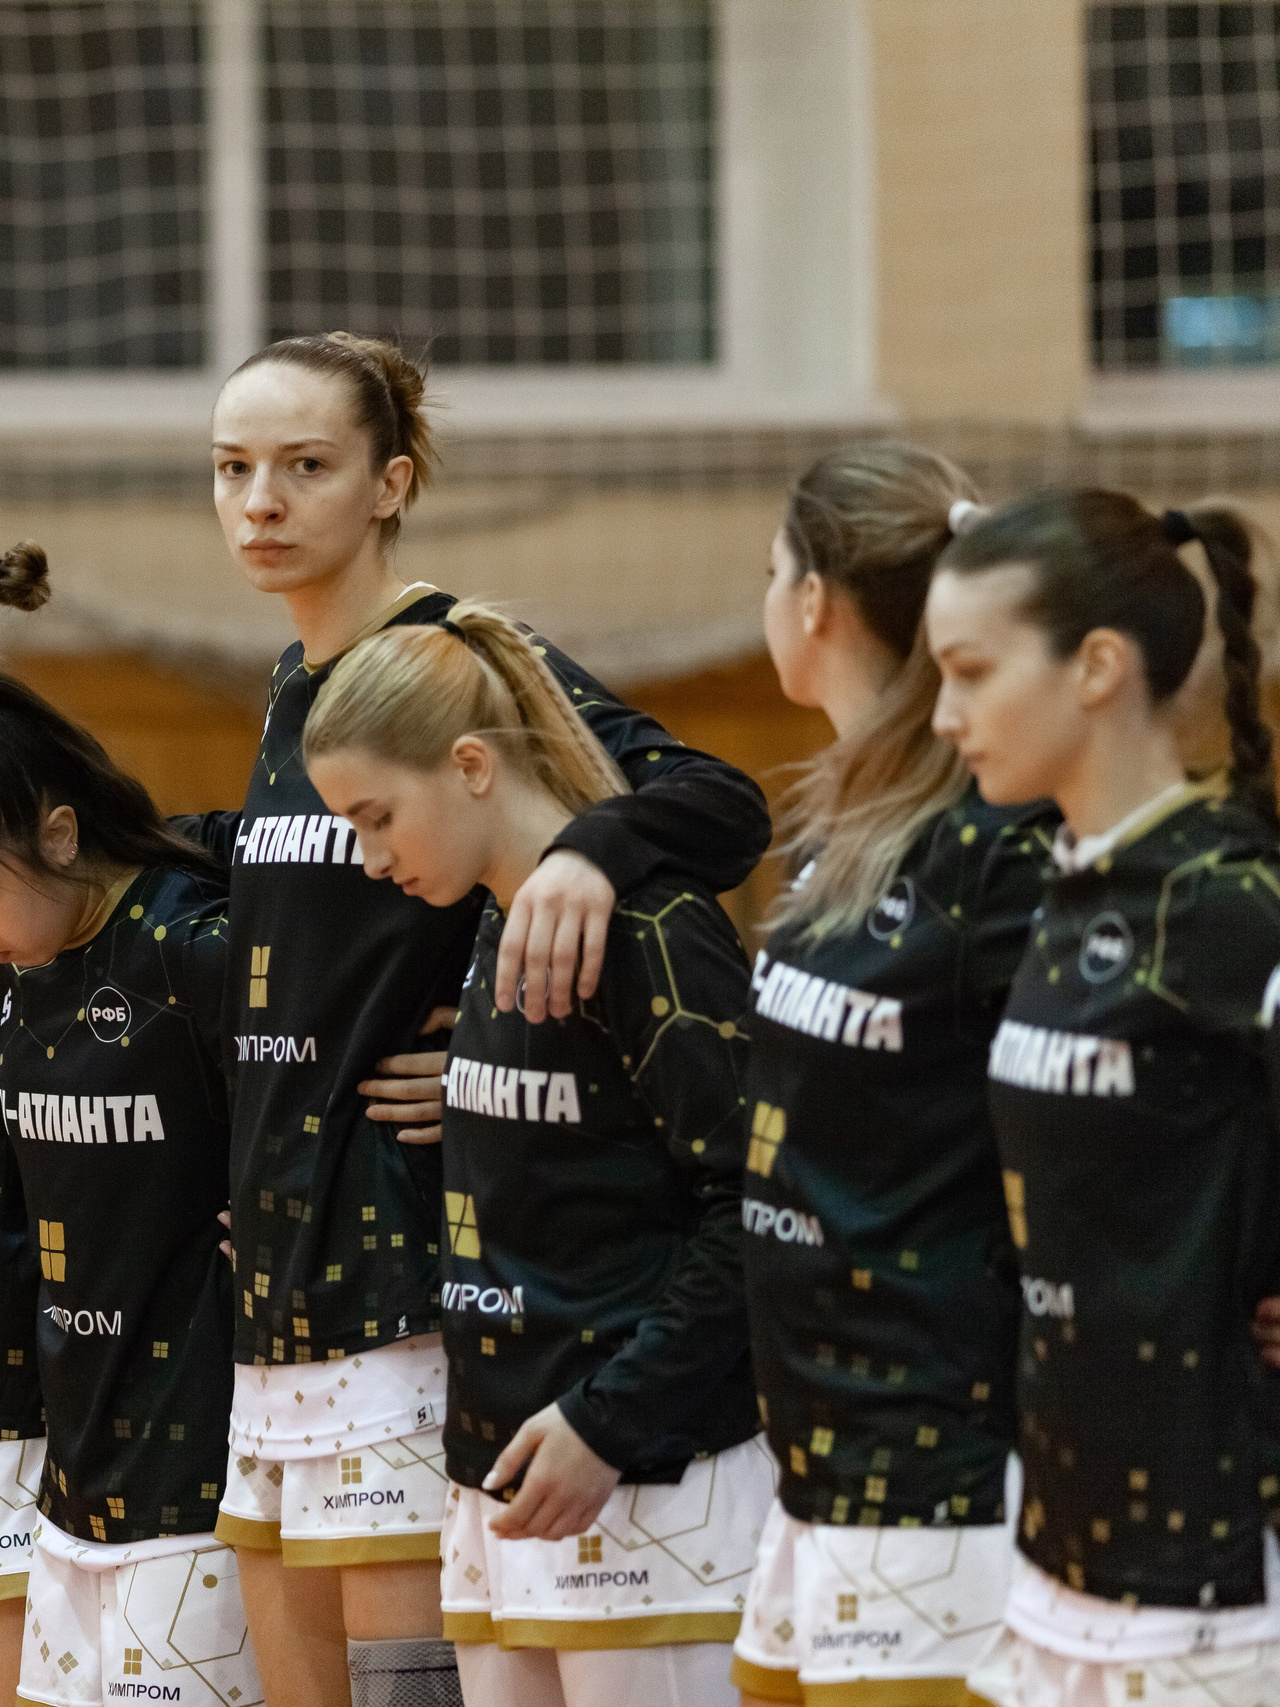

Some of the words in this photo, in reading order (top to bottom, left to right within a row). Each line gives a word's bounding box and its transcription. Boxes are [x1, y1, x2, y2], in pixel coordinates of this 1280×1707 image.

[91, 1006, 127, 1022] РФБ
[555, 1569, 649, 1590] ХИМПРОМ
[108, 1682, 180, 1701] ХИМПРОМ
